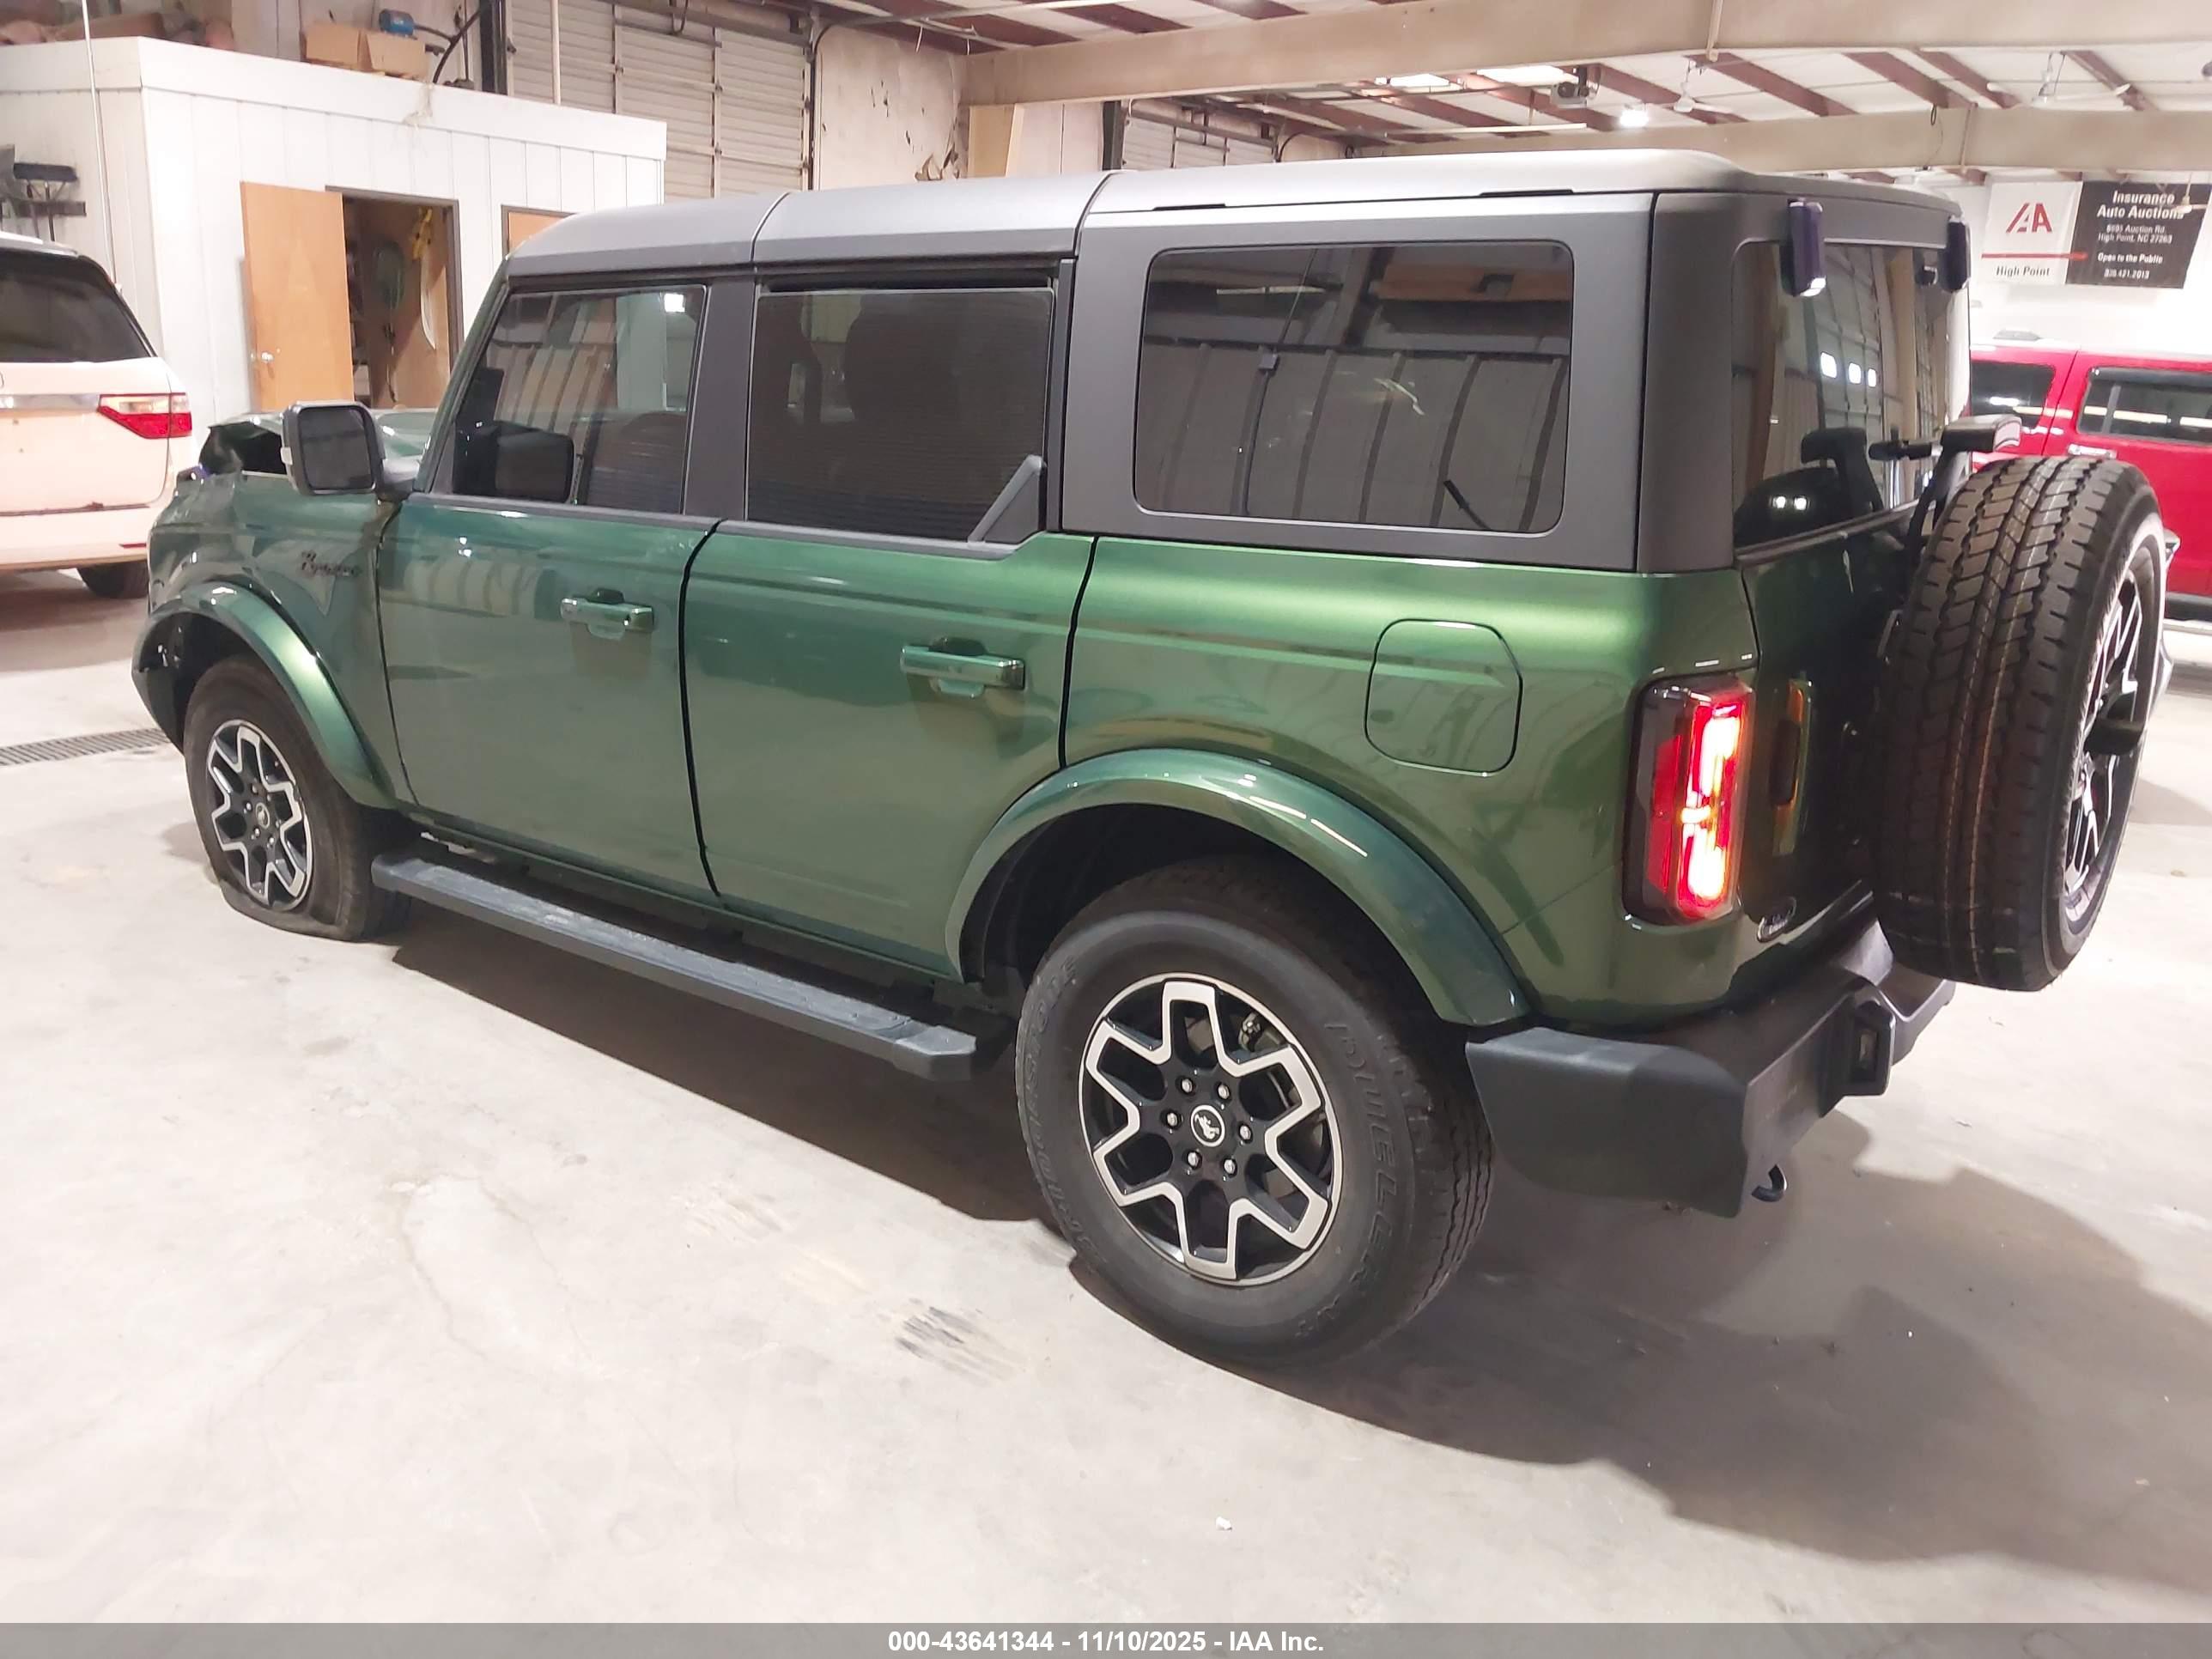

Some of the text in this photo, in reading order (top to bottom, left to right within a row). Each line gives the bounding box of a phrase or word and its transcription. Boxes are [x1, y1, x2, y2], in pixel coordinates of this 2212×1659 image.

[2112, 190, 2175, 205] Insurance
[2097, 204, 2125, 219] Auto
[2124, 224, 2153, 234] Auction
[2098, 233, 2114, 243] High
[2137, 234, 2148, 243] NC
[2097, 252, 2163, 264] Open to the Public
[1996, 266, 2051, 277] High Point
